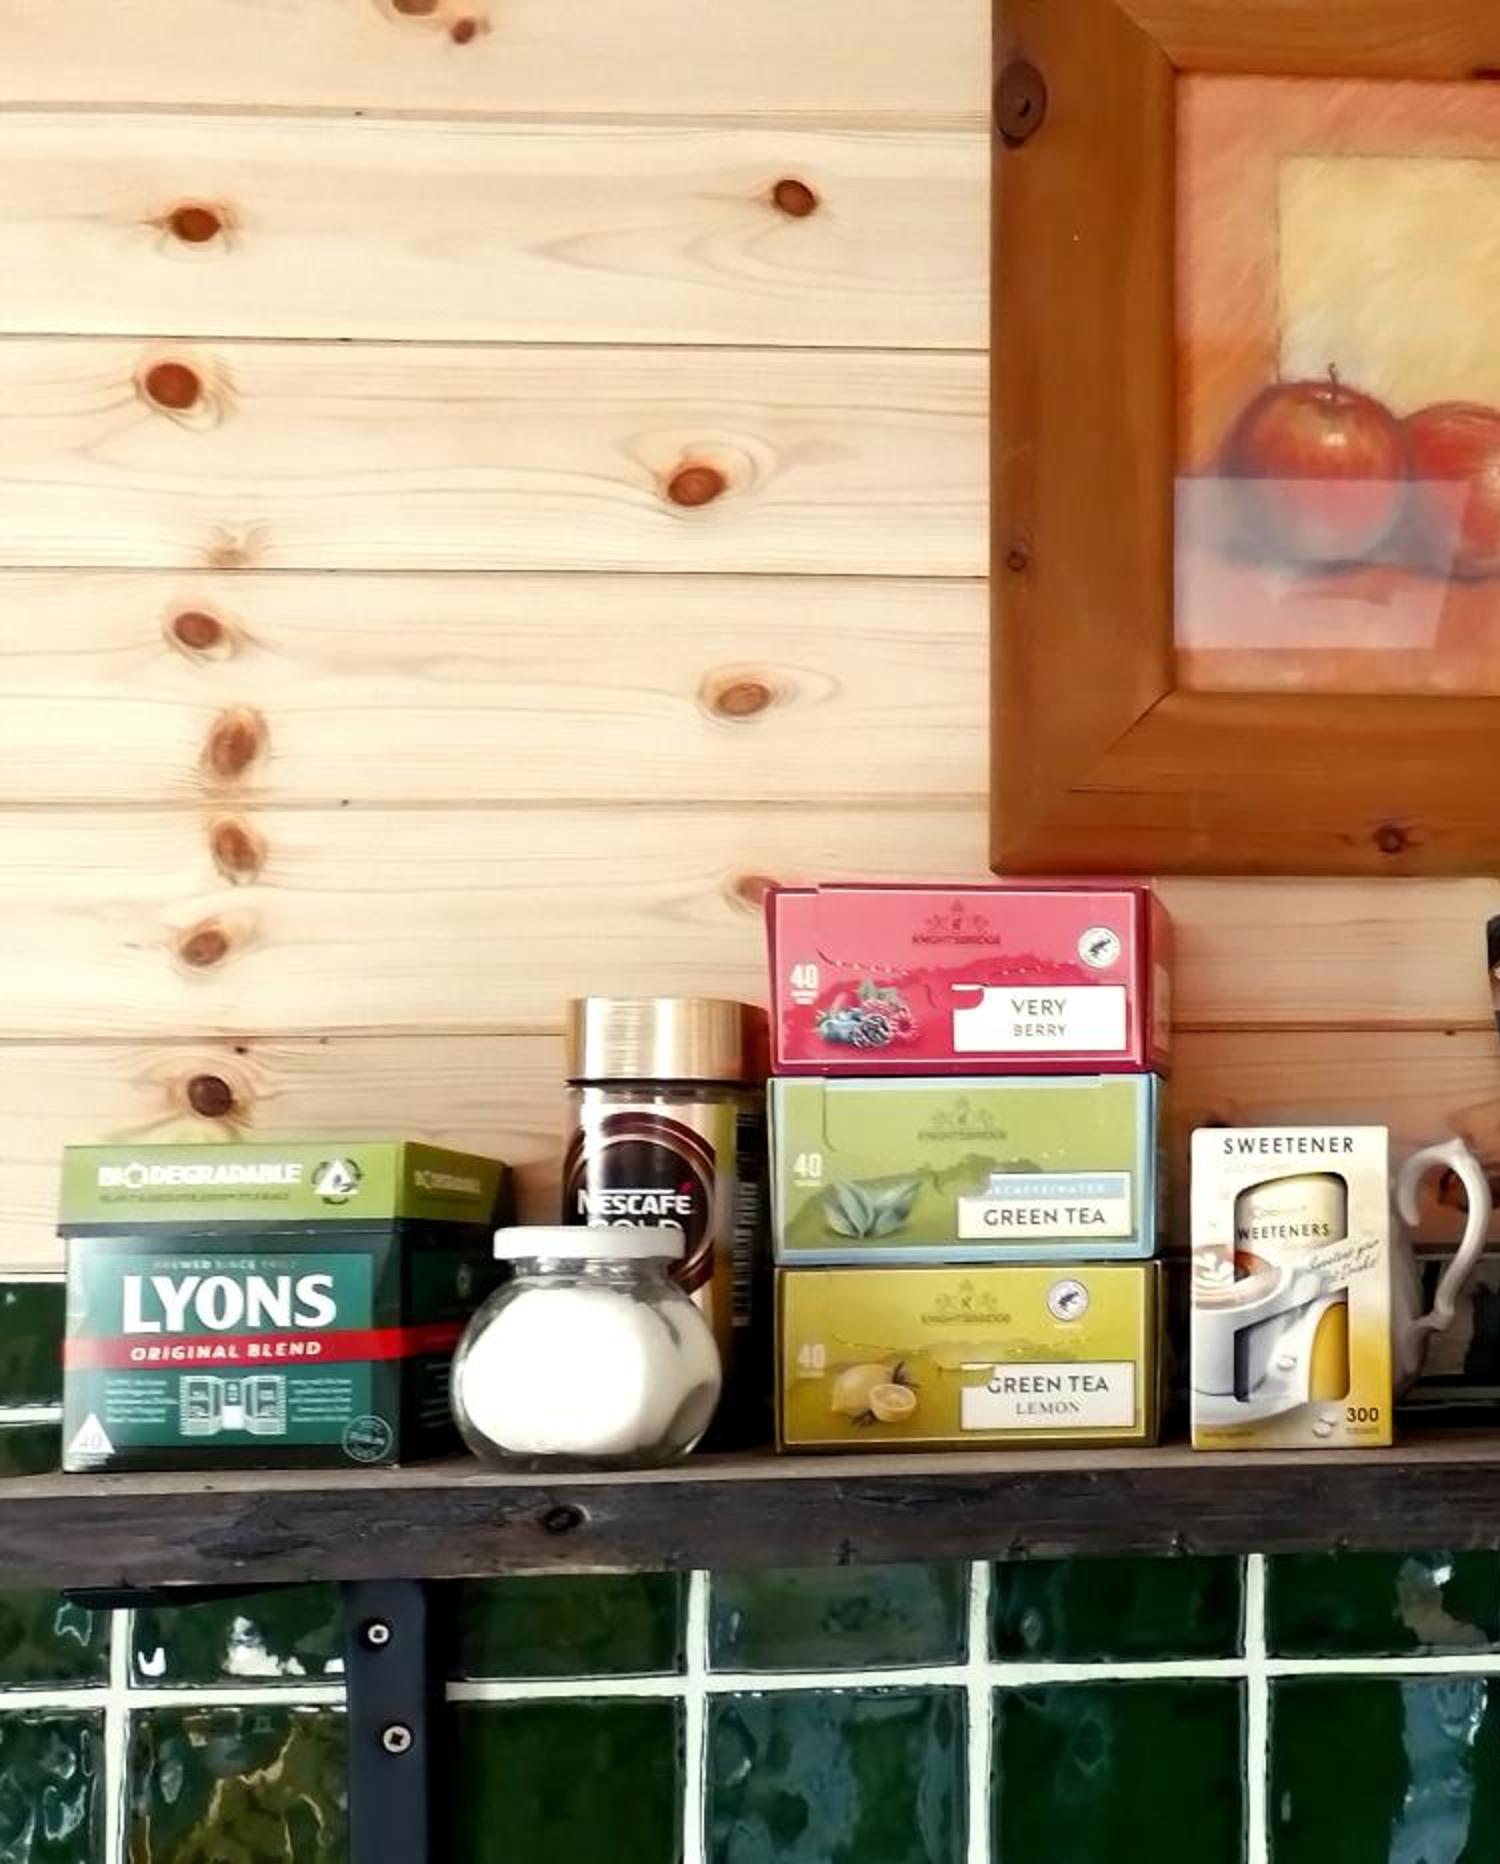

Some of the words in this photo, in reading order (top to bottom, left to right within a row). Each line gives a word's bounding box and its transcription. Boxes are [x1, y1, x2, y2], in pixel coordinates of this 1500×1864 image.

[790, 964, 819, 988] 40
[1011, 999, 1067, 1016] VERY
[1012, 1023, 1067, 1037] BERRY
[1223, 1137, 1354, 1154] SWEETENER
[794, 1153, 822, 1177] 40
[98, 1163, 303, 1188] BIODEGRADABLE
[983, 1209, 1058, 1226] GREEN
[1066, 1207, 1106, 1225] TEA
[123, 1273, 337, 1334] LYONS
[130, 1344, 240, 1361] ORIGINAL
[247, 1340, 321, 1358] BLEND
[987, 1377, 1061, 1394] GREEN
[1069, 1375, 1109, 1393] TEA
[1015, 1400, 1080, 1415] LEMON
[1346, 1407, 1379, 1423] 300
